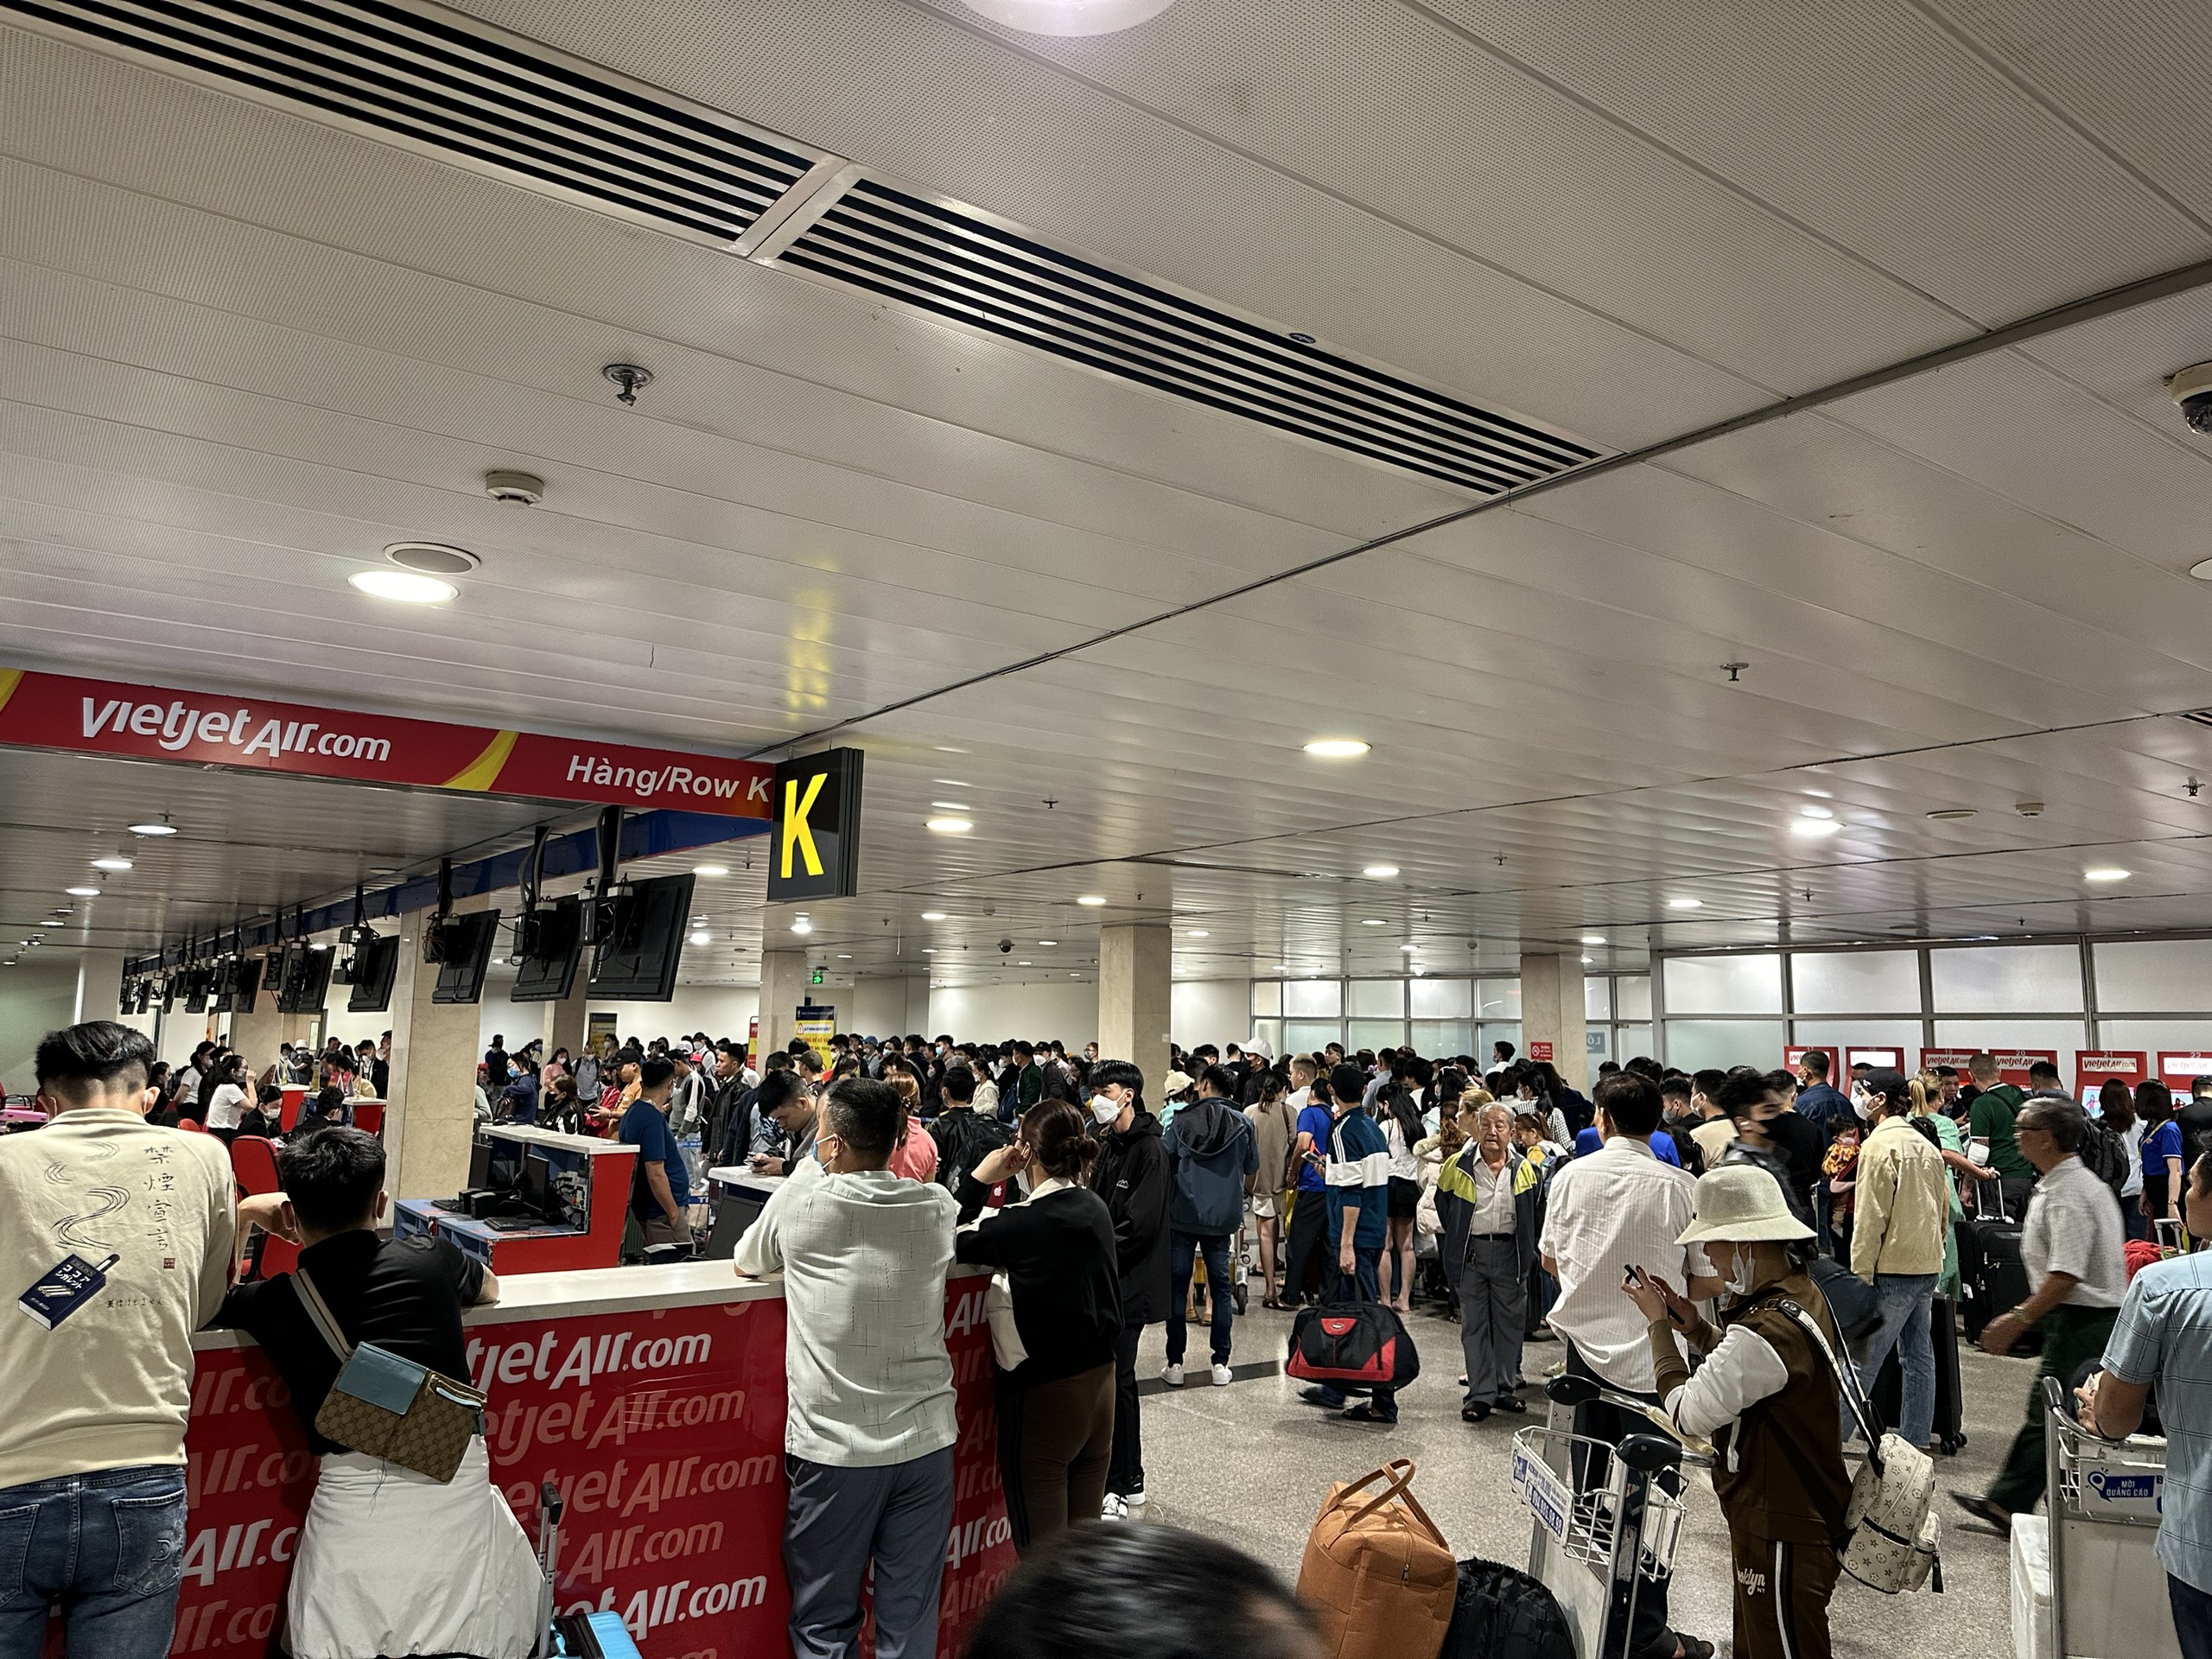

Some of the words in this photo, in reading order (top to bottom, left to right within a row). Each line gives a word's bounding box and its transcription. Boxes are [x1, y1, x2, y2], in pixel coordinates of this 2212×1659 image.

[566, 754, 741, 798] Hàng/Row
[747, 776, 772, 803] K
[781, 772, 828, 879] K
[143, 1146, 175, 1250] 禁煙宣言
[62, 1264, 91, 1282] ココア
[2107, 1487, 2132, 1497] QUẢNG
